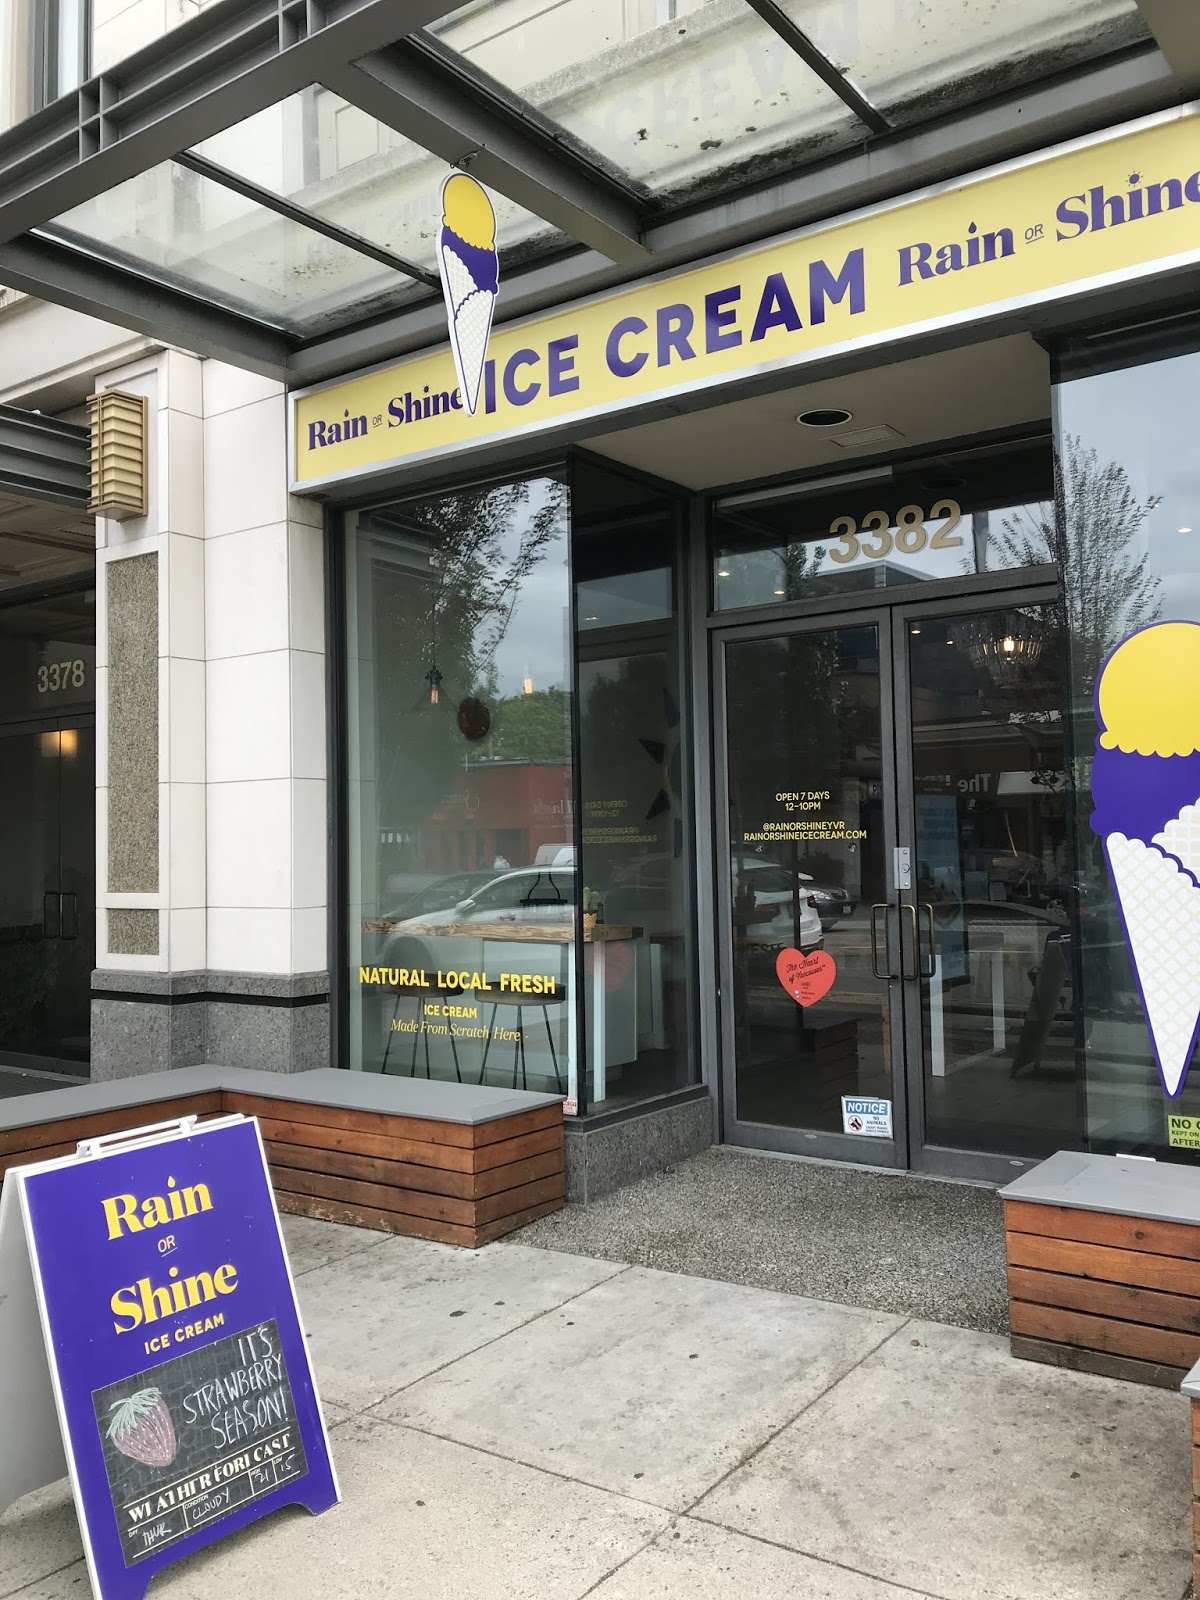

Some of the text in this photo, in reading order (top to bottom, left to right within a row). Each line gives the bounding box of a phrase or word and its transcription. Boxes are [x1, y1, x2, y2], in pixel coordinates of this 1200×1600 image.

[897, 170, 1200, 287] Rain OR Shine
[485, 248, 867, 414] ICE CREAM
[308, 384, 463, 451] Rain OR Shine
[829, 499, 963, 564] 3382
[37, 659, 85, 693] 3378
[775, 791, 830, 802] OPEN 7 DAYS
[785, 802, 821, 811] 12-10PM
[744, 830, 867, 841] RAINORSHINEICECREAM.COM
[763, 821, 845, 831] @RAINORSHINEYVR
[359, 967, 556, 995] NATURAL LOCAL FRESH
[424, 1004, 478, 1019] ICE CREAM
[391, 1018, 521, 1042] Made From Scratch Here
[847, 1101, 886, 1114] NOTICE
[1171, 1118, 1192, 1129] NO
[1172, 1138, 1200, 1147] AFTER
[101, 1176, 214, 1241] Rain
[157, 1235, 178, 1257] OR
[110, 1264, 239, 1335] Shine
[144, 1313, 225, 1355] ICE CREAM
[238, 1325, 273, 1366] IT'S
[183, 1353, 282, 1424] STRAWBERRY
[211, 1386, 289, 1449] SEASON!
[254, 1469, 269, 1483] 21
[184, 1494, 209, 1510] CONDITION
[192, 1487, 230, 1520] CLOUDY
[128, 1529, 138, 1538] DAY
